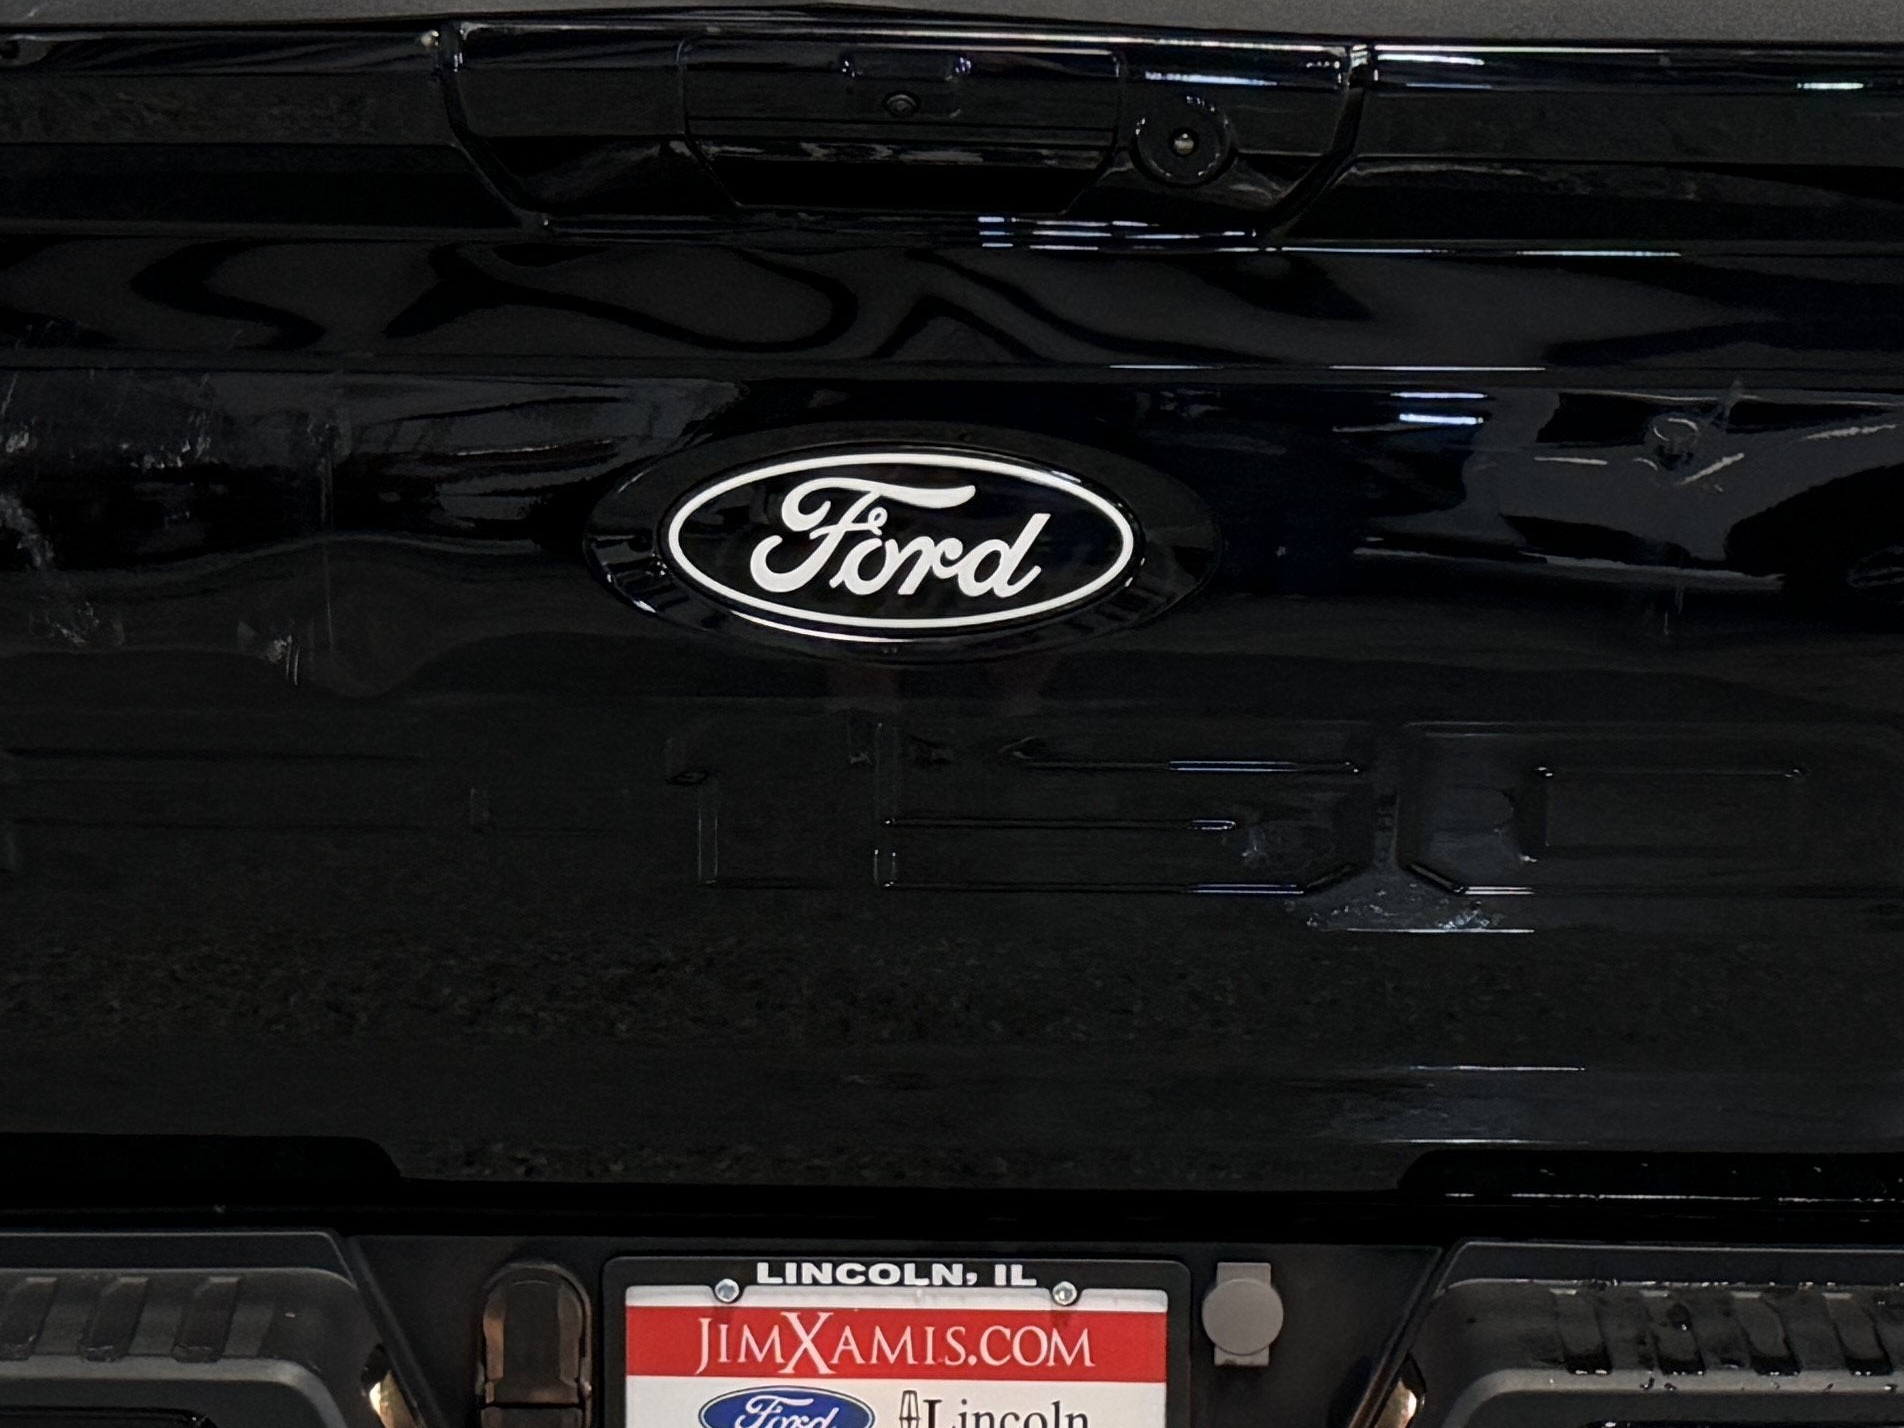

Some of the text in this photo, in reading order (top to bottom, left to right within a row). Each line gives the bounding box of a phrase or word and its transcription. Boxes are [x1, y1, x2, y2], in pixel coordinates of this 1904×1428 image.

[750, 476, 1052, 600] Ford
[753, 1262, 1037, 1289] LINCOLN, IL
